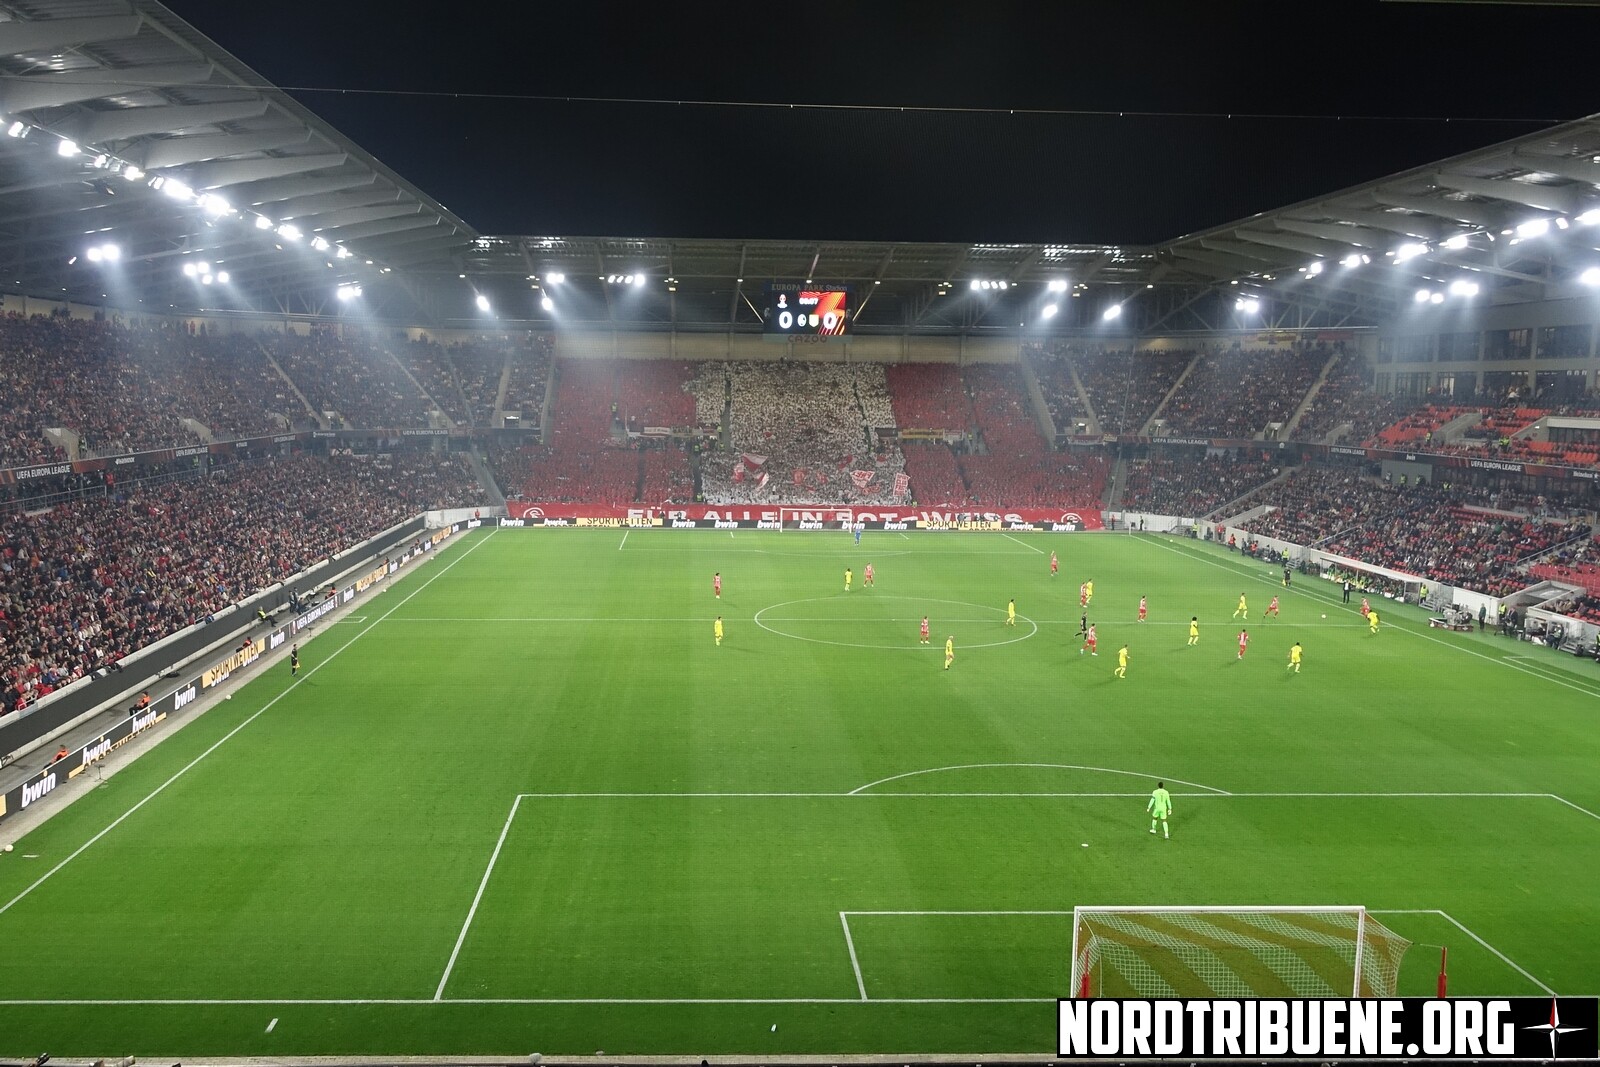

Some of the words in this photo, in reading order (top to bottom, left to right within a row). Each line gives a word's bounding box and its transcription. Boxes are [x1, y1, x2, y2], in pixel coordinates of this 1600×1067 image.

[779, 311, 792, 329] 0
[823, 312, 837, 330] 0
[788, 335, 828, 343] CAZOO
[16, 471, 31, 480] UEFA
[31, 467, 51, 478] EUROPA
[51, 464, 70, 475] LEAGUE
[1502, 464, 1522, 472] LEAGUE
[500, 518, 524, 526] bwin
[672, 519, 696, 528] bwin
[714, 520, 738, 528] bwin
[757, 520, 780, 529] bwin
[799, 520, 823, 529] bwin
[884, 521, 907, 530] bwin
[1052, 523, 1075, 531] bwin
[297, 614, 308, 630] UEFA
[271, 629, 285, 650] bwin
[175, 683, 196, 710] bwin
[22, 769, 56, 808] bwin
